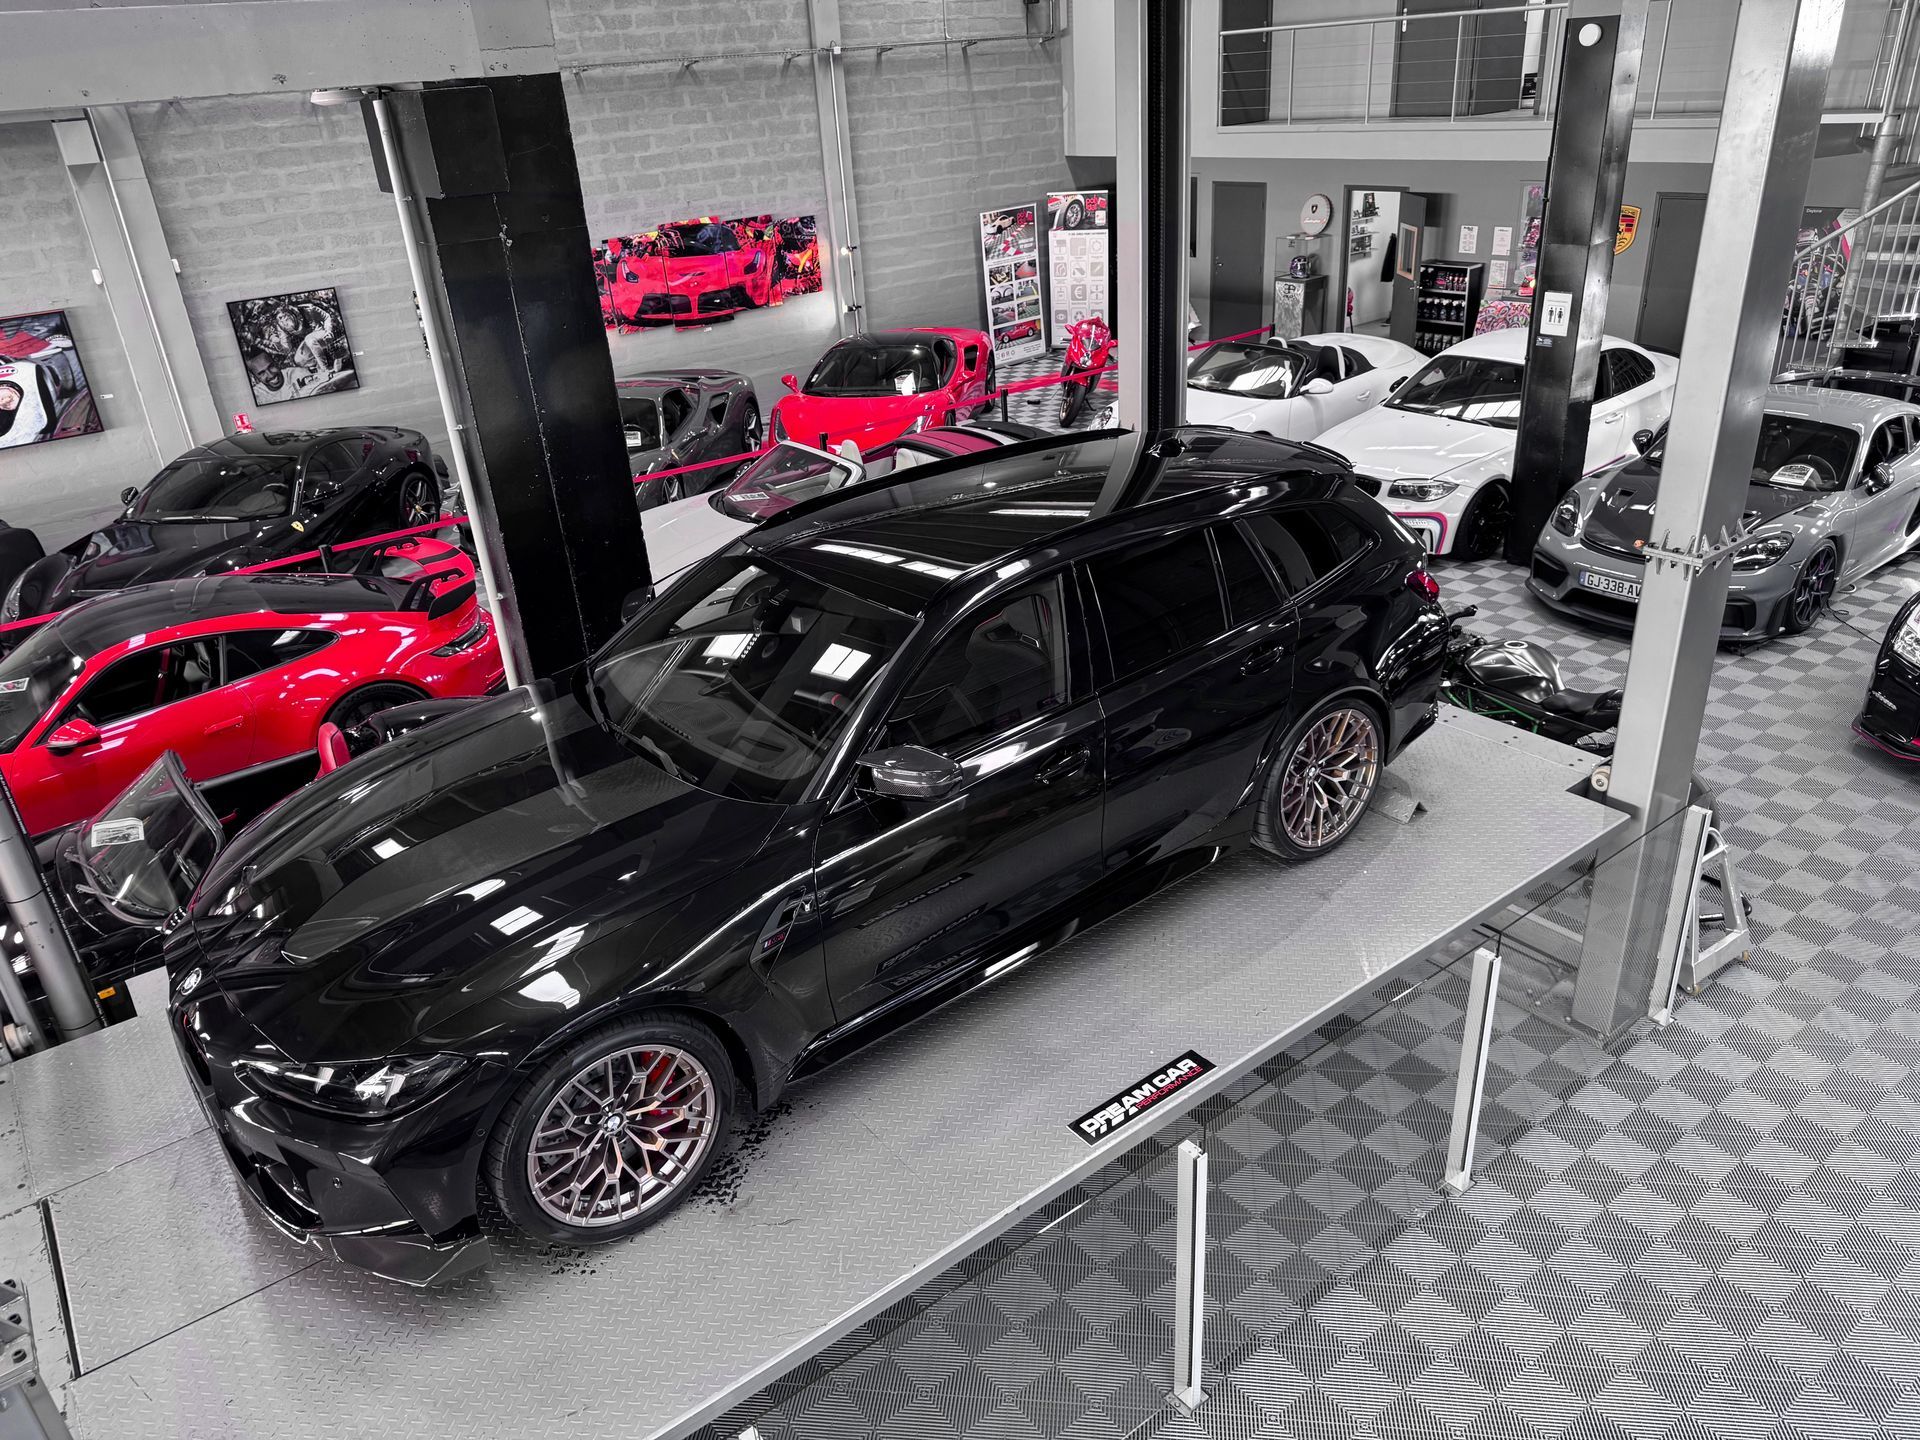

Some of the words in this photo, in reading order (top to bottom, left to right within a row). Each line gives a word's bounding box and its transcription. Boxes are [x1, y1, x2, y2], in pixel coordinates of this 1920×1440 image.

[1587, 574, 1641, 597] GJ-338-AV
[1080, 1083, 1157, 1135] DREAM
[1152, 1058, 1198, 1088] CAR
[1136, 1065, 1204, 1109] PERFORMANCE
